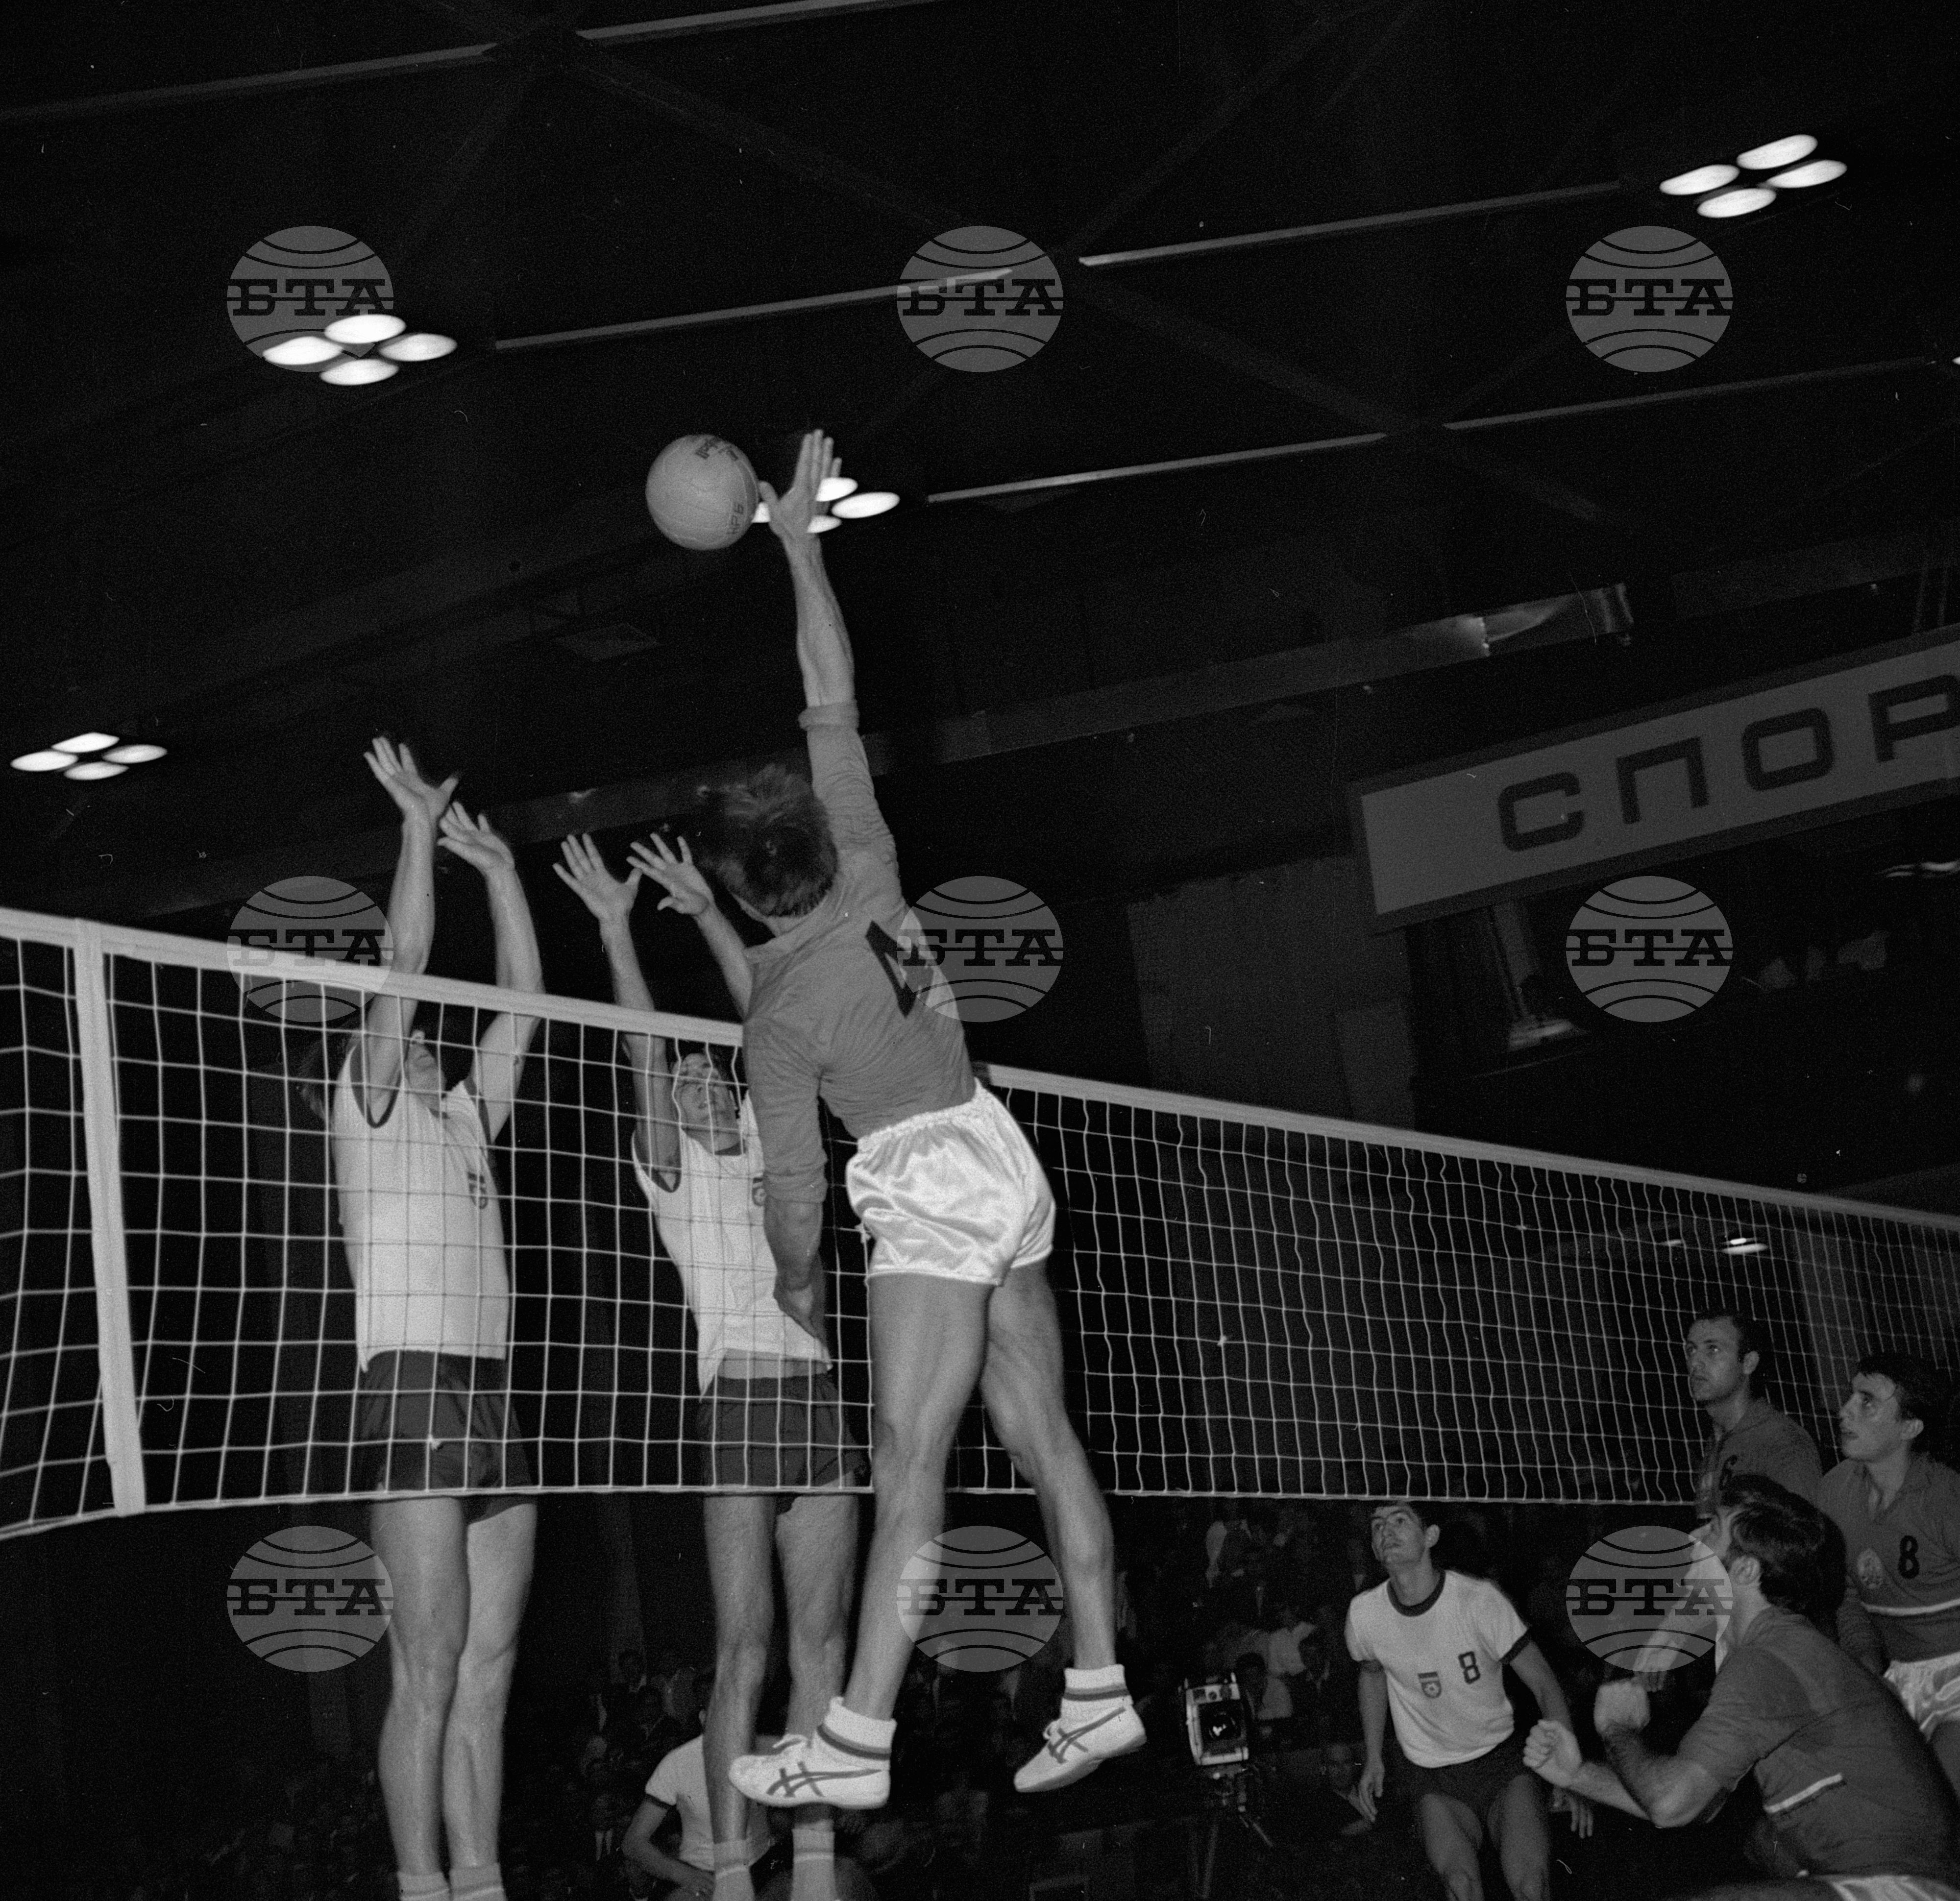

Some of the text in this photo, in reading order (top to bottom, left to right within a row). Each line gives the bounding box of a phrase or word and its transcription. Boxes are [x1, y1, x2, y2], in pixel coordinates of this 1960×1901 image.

[1497, 674, 1960, 852] СПОР
[1898, 1535, 1920, 1579] 8
[1458, 1651, 1481, 1685] 8
